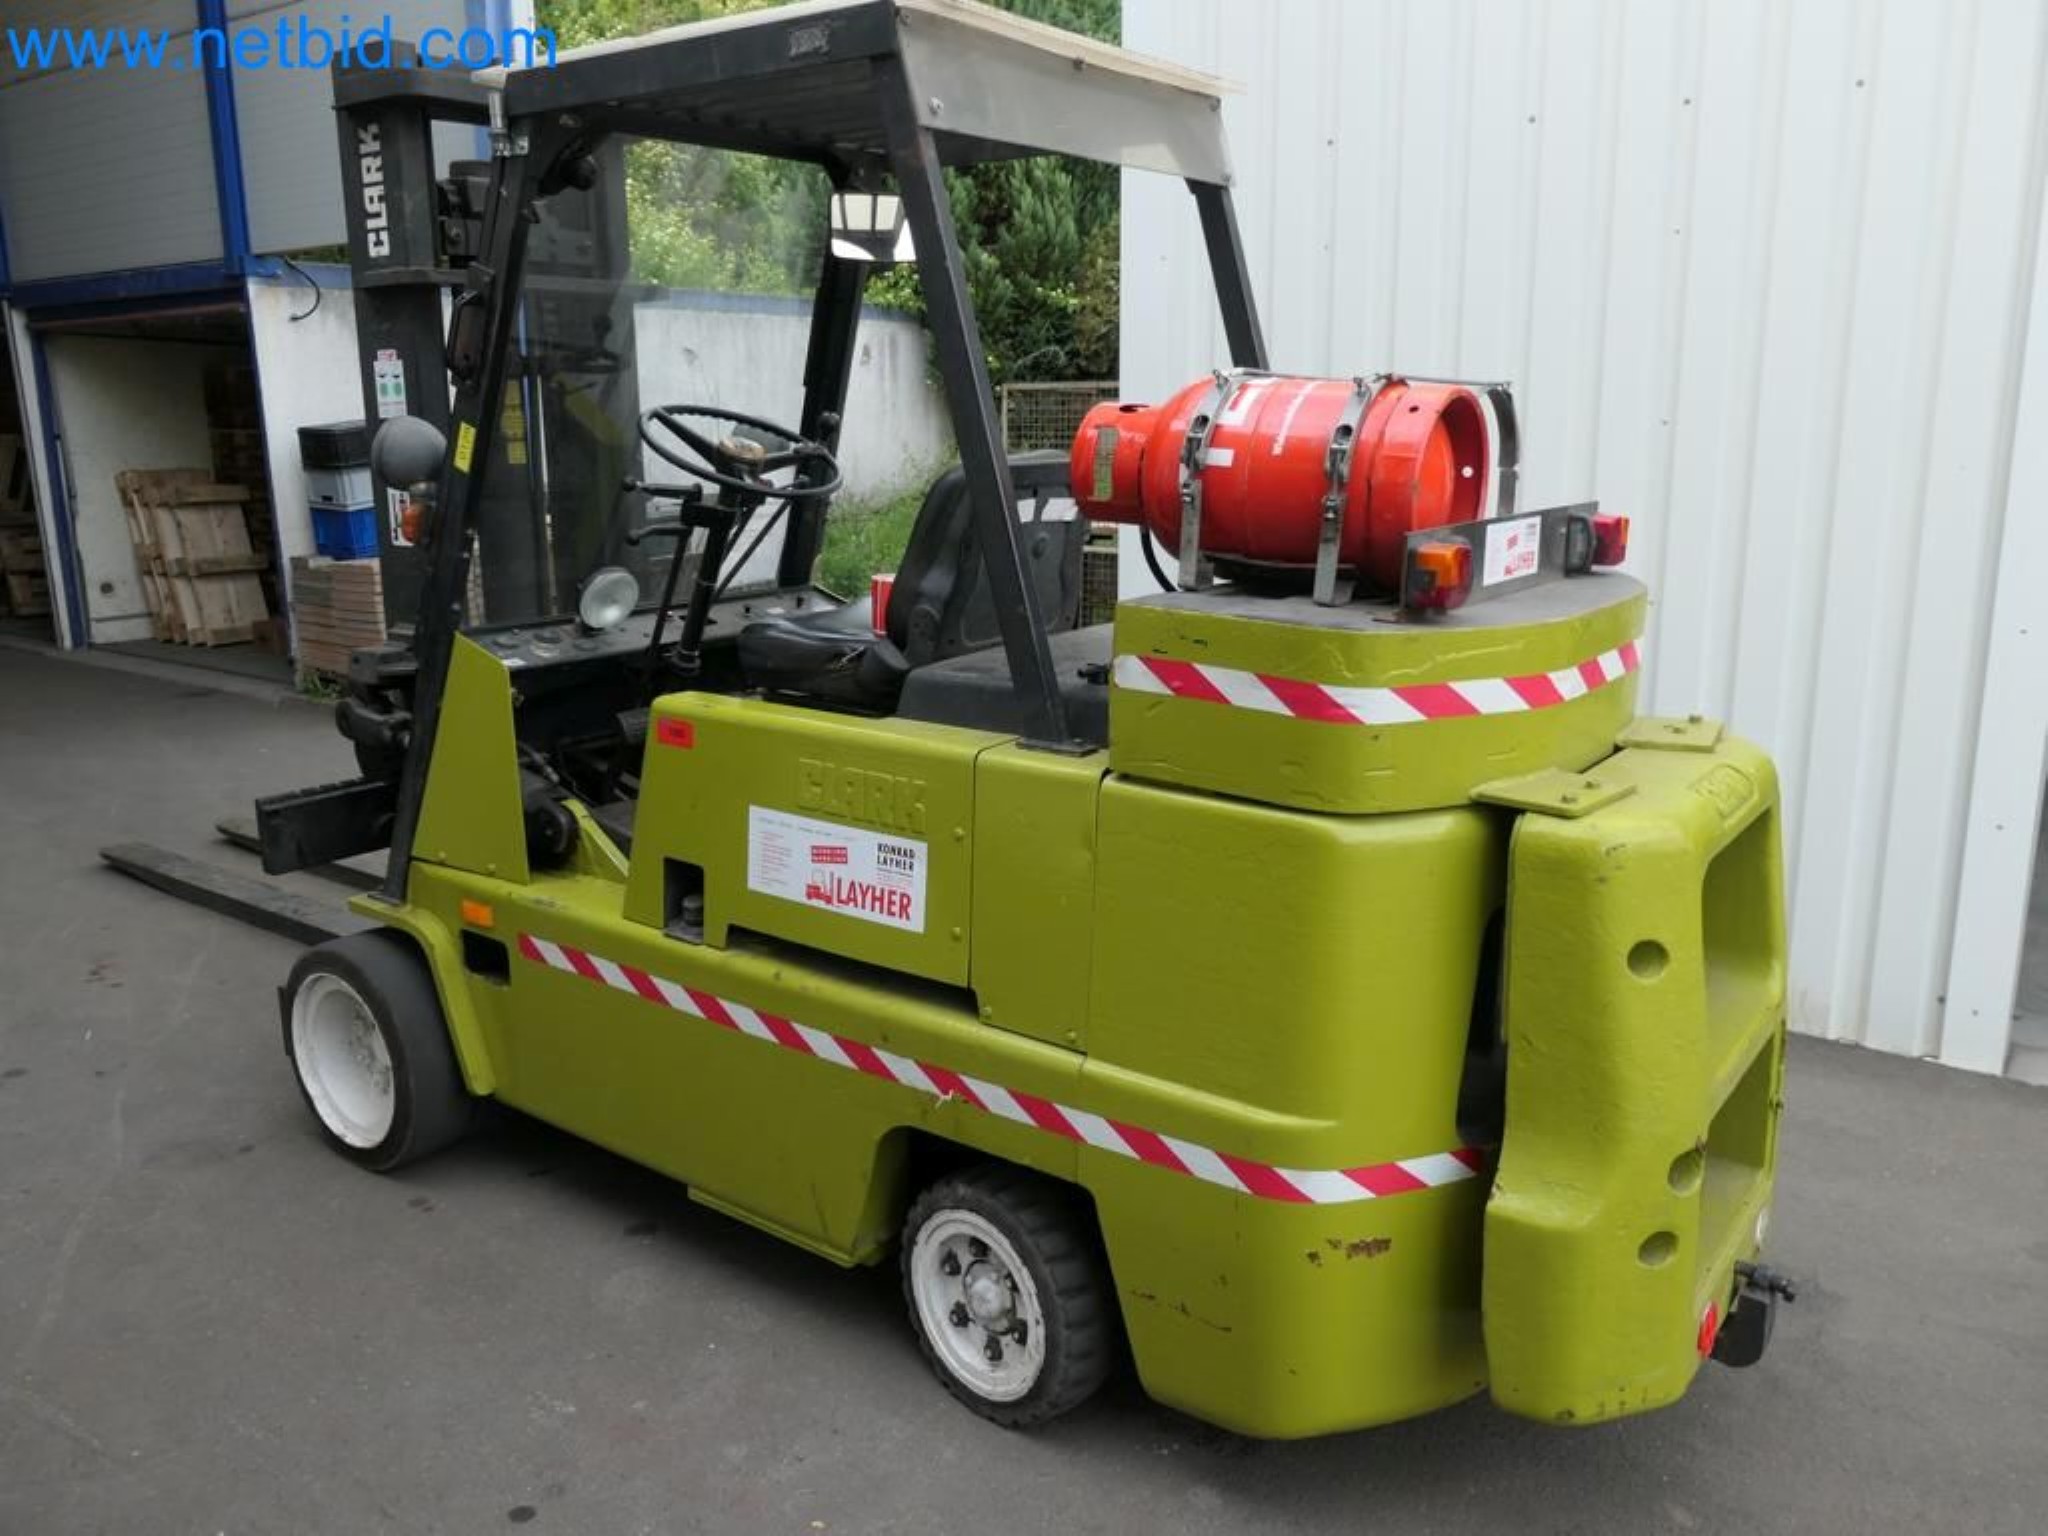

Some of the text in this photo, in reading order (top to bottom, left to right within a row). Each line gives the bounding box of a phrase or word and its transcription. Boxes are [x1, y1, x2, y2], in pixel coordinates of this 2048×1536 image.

[359, 123, 390, 257] CLARK
[798, 757, 927, 834] CLARK
[877, 843, 916, 860] KONRAD
[877, 855, 914, 871] LAYHER
[836, 876, 912, 921] LAYHER
